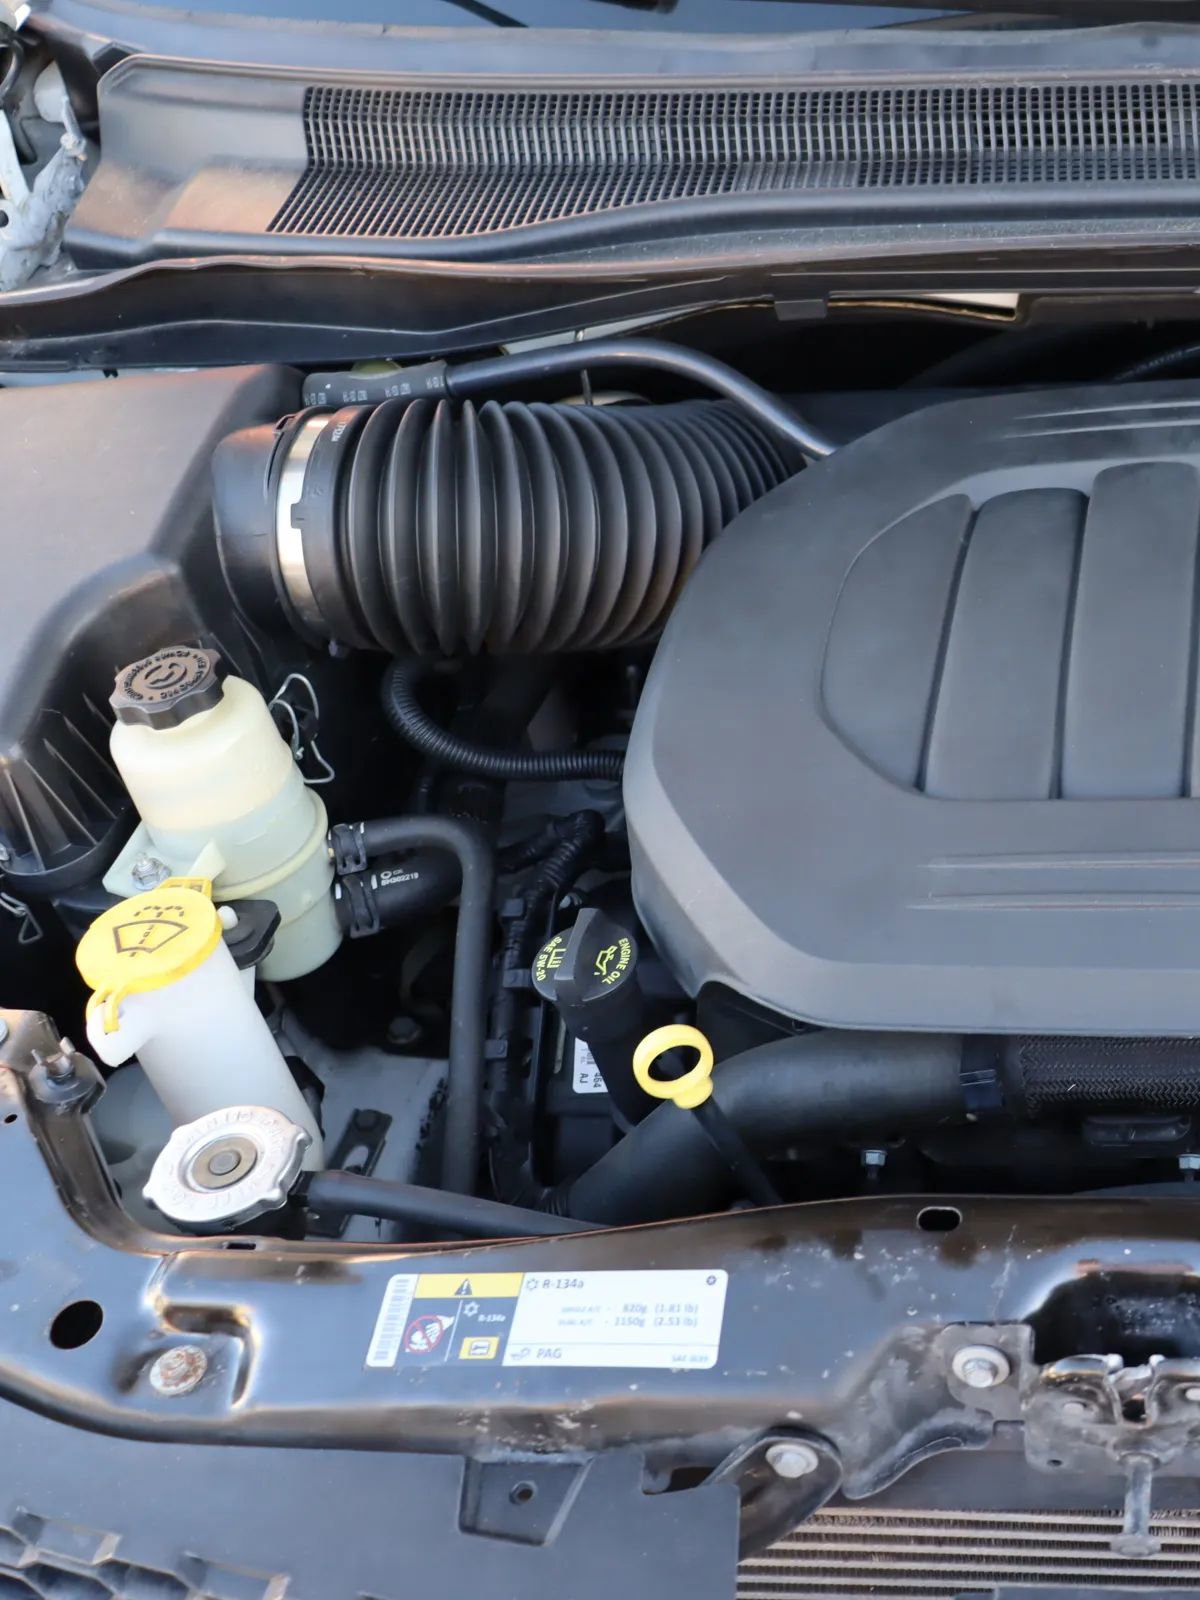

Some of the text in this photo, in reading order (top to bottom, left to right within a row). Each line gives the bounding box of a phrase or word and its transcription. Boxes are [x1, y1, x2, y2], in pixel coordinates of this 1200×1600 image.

[536, 936, 563, 981] SAE 5W-20
[602, 938, 631, 985] ENGINE OIL
[542, 1278, 585, 1290] R-134a
[622, 1303, 648, 1315] 820g
[654, 1303, 681, 1315] (1.81
[684, 1303, 699, 1315] lb)
[614, 1316, 646, 1328] 1150g
[653, 1316, 680, 1328] (2.53
[683, 1316, 698, 1328] lb)
[536, 1348, 562, 1359] PAG
